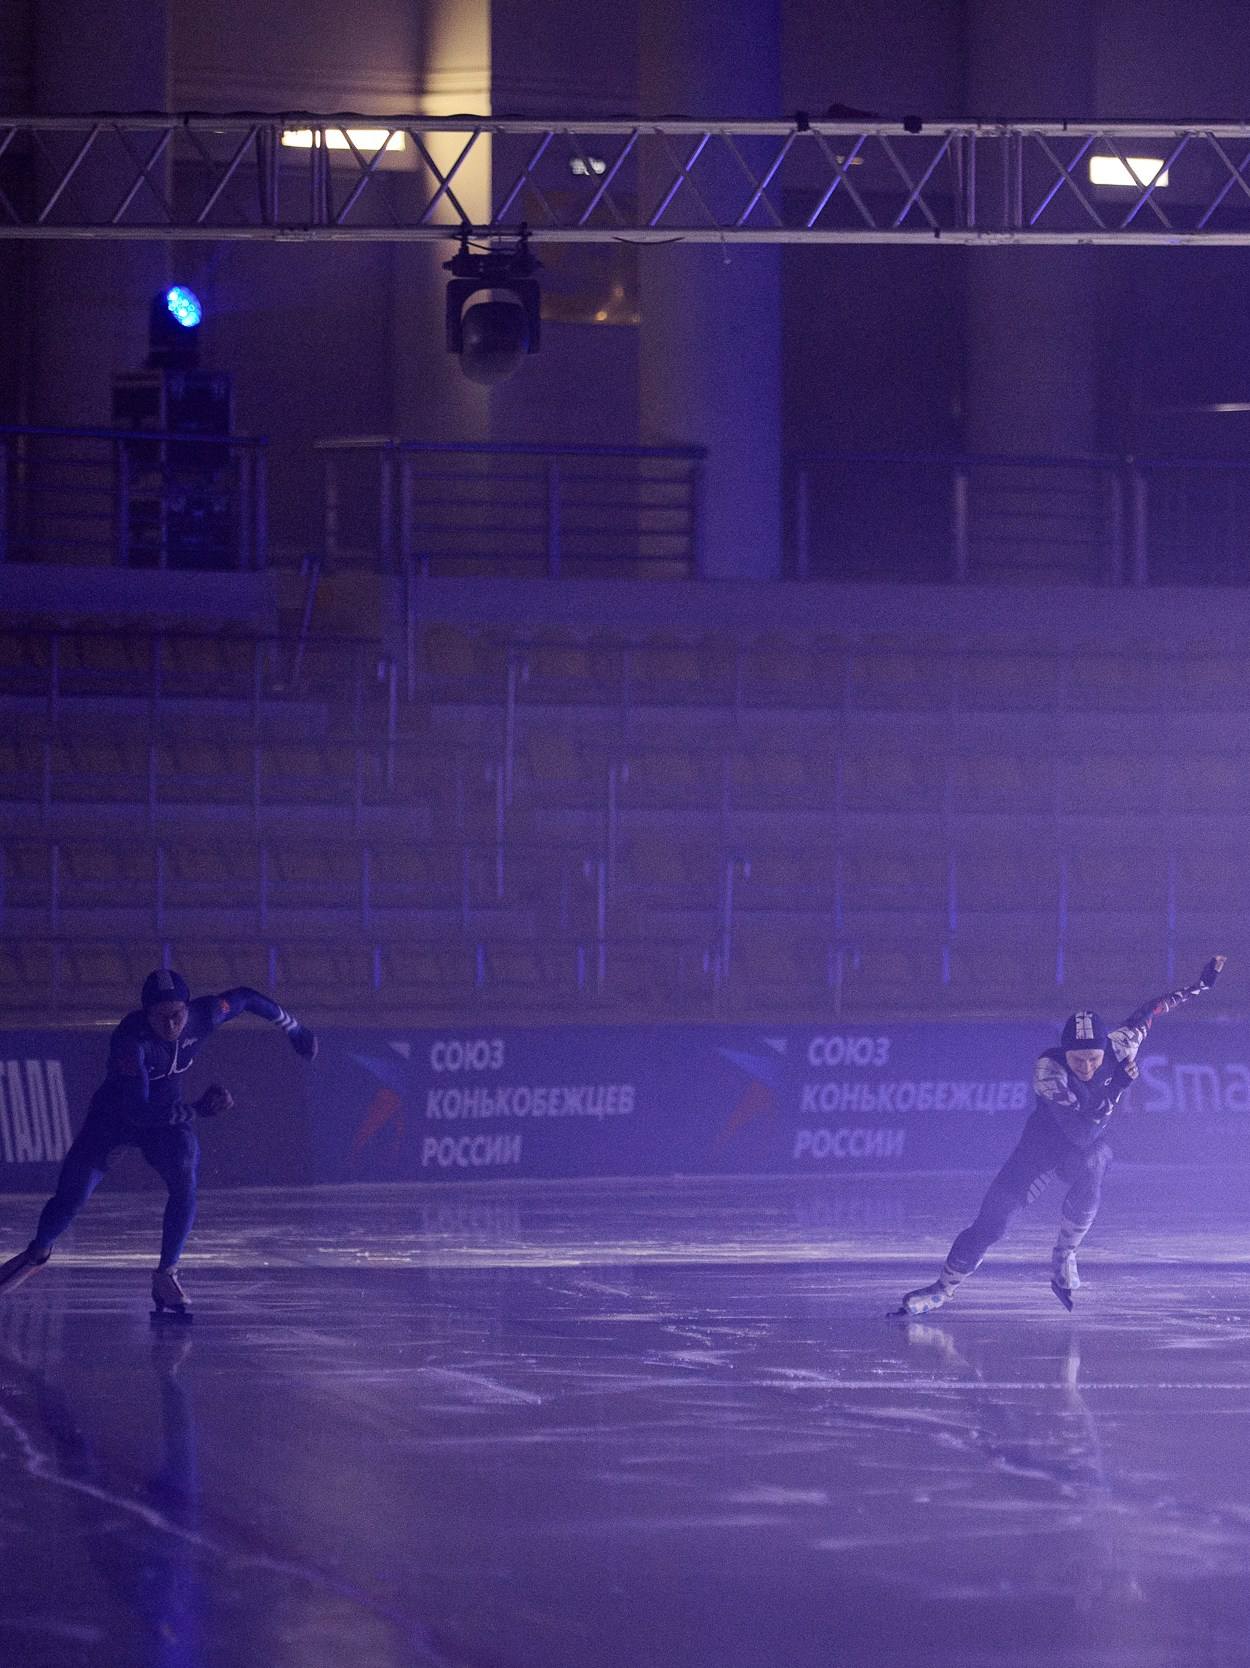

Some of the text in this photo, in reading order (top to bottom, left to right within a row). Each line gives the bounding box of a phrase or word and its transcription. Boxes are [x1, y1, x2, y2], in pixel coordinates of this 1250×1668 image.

[430, 1039, 504, 1070] СОЮЗ
[808, 1036, 890, 1067] СОЮЗ
[426, 1085, 636, 1120] КОНЬКОБЕЖЦЕВ
[800, 1080, 1029, 1115] КОНЬКОБЕЖЦЕВ
[421, 1133, 523, 1167] РОССИИ
[793, 1128, 906, 1159] РОССИИ
